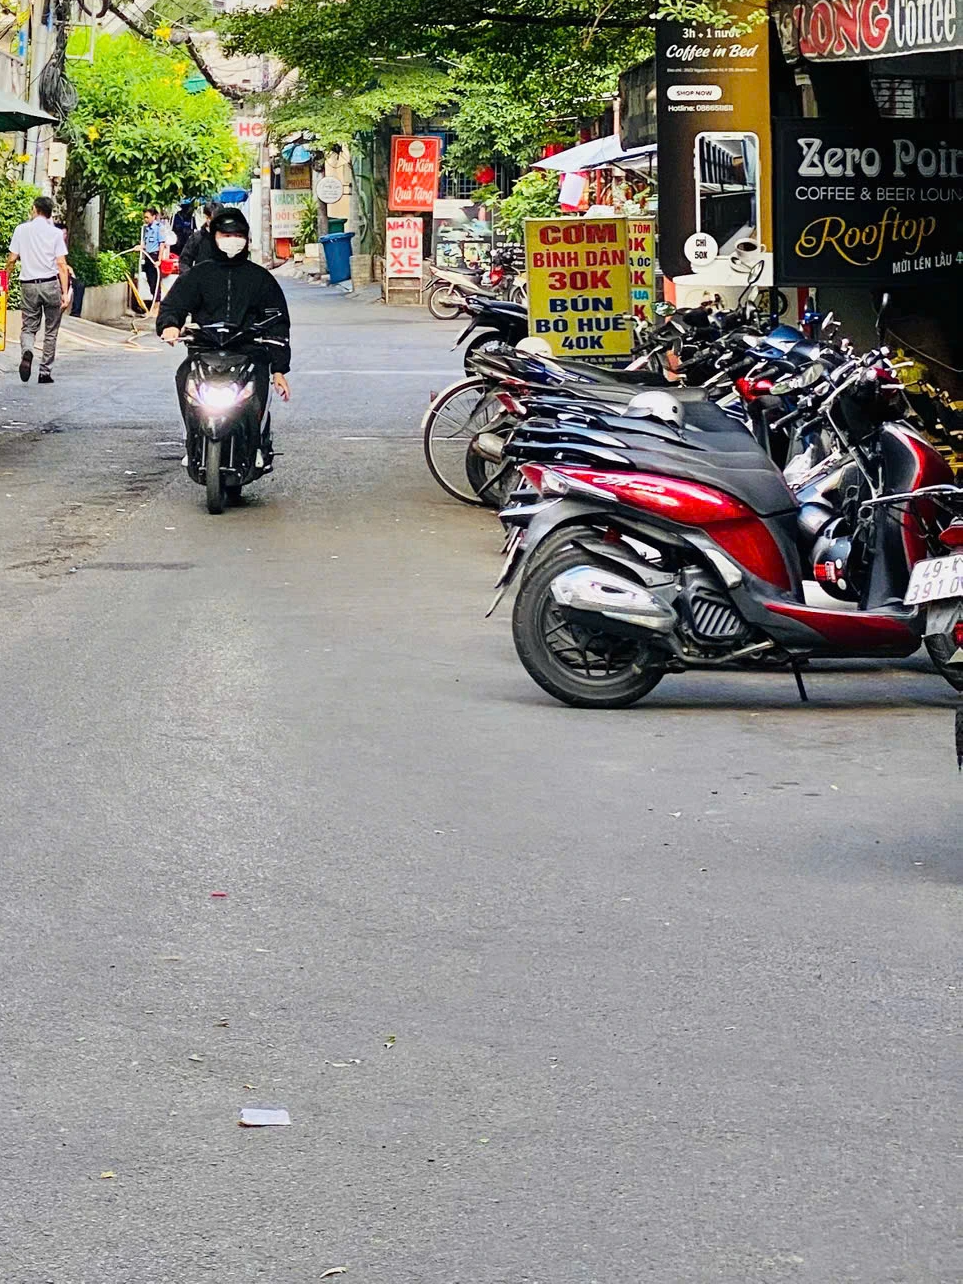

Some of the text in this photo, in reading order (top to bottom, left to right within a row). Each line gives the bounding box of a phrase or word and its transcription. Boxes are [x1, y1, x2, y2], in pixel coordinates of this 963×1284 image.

[682, 27, 696, 38] 3h
[706, 27, 712, 38] 1
[666, 44, 759, 61] Coffee in Bed
[796, 137, 882, 178] Zero
[795, 186, 855, 201] COFFEE
[859, 187, 872, 201] &
[876, 187, 915, 201] BEER
[539, 223, 617, 245] CƠM
[795, 206, 937, 266] Rooftop
[586, 247, 625, 267] DÂN
[914, 256, 931, 270] LÊN
[548, 269, 612, 291] 30K
[549, 294, 613, 313] BÚN
[536, 315, 569, 333] BÒ
[561, 336, 604, 350] 40K
